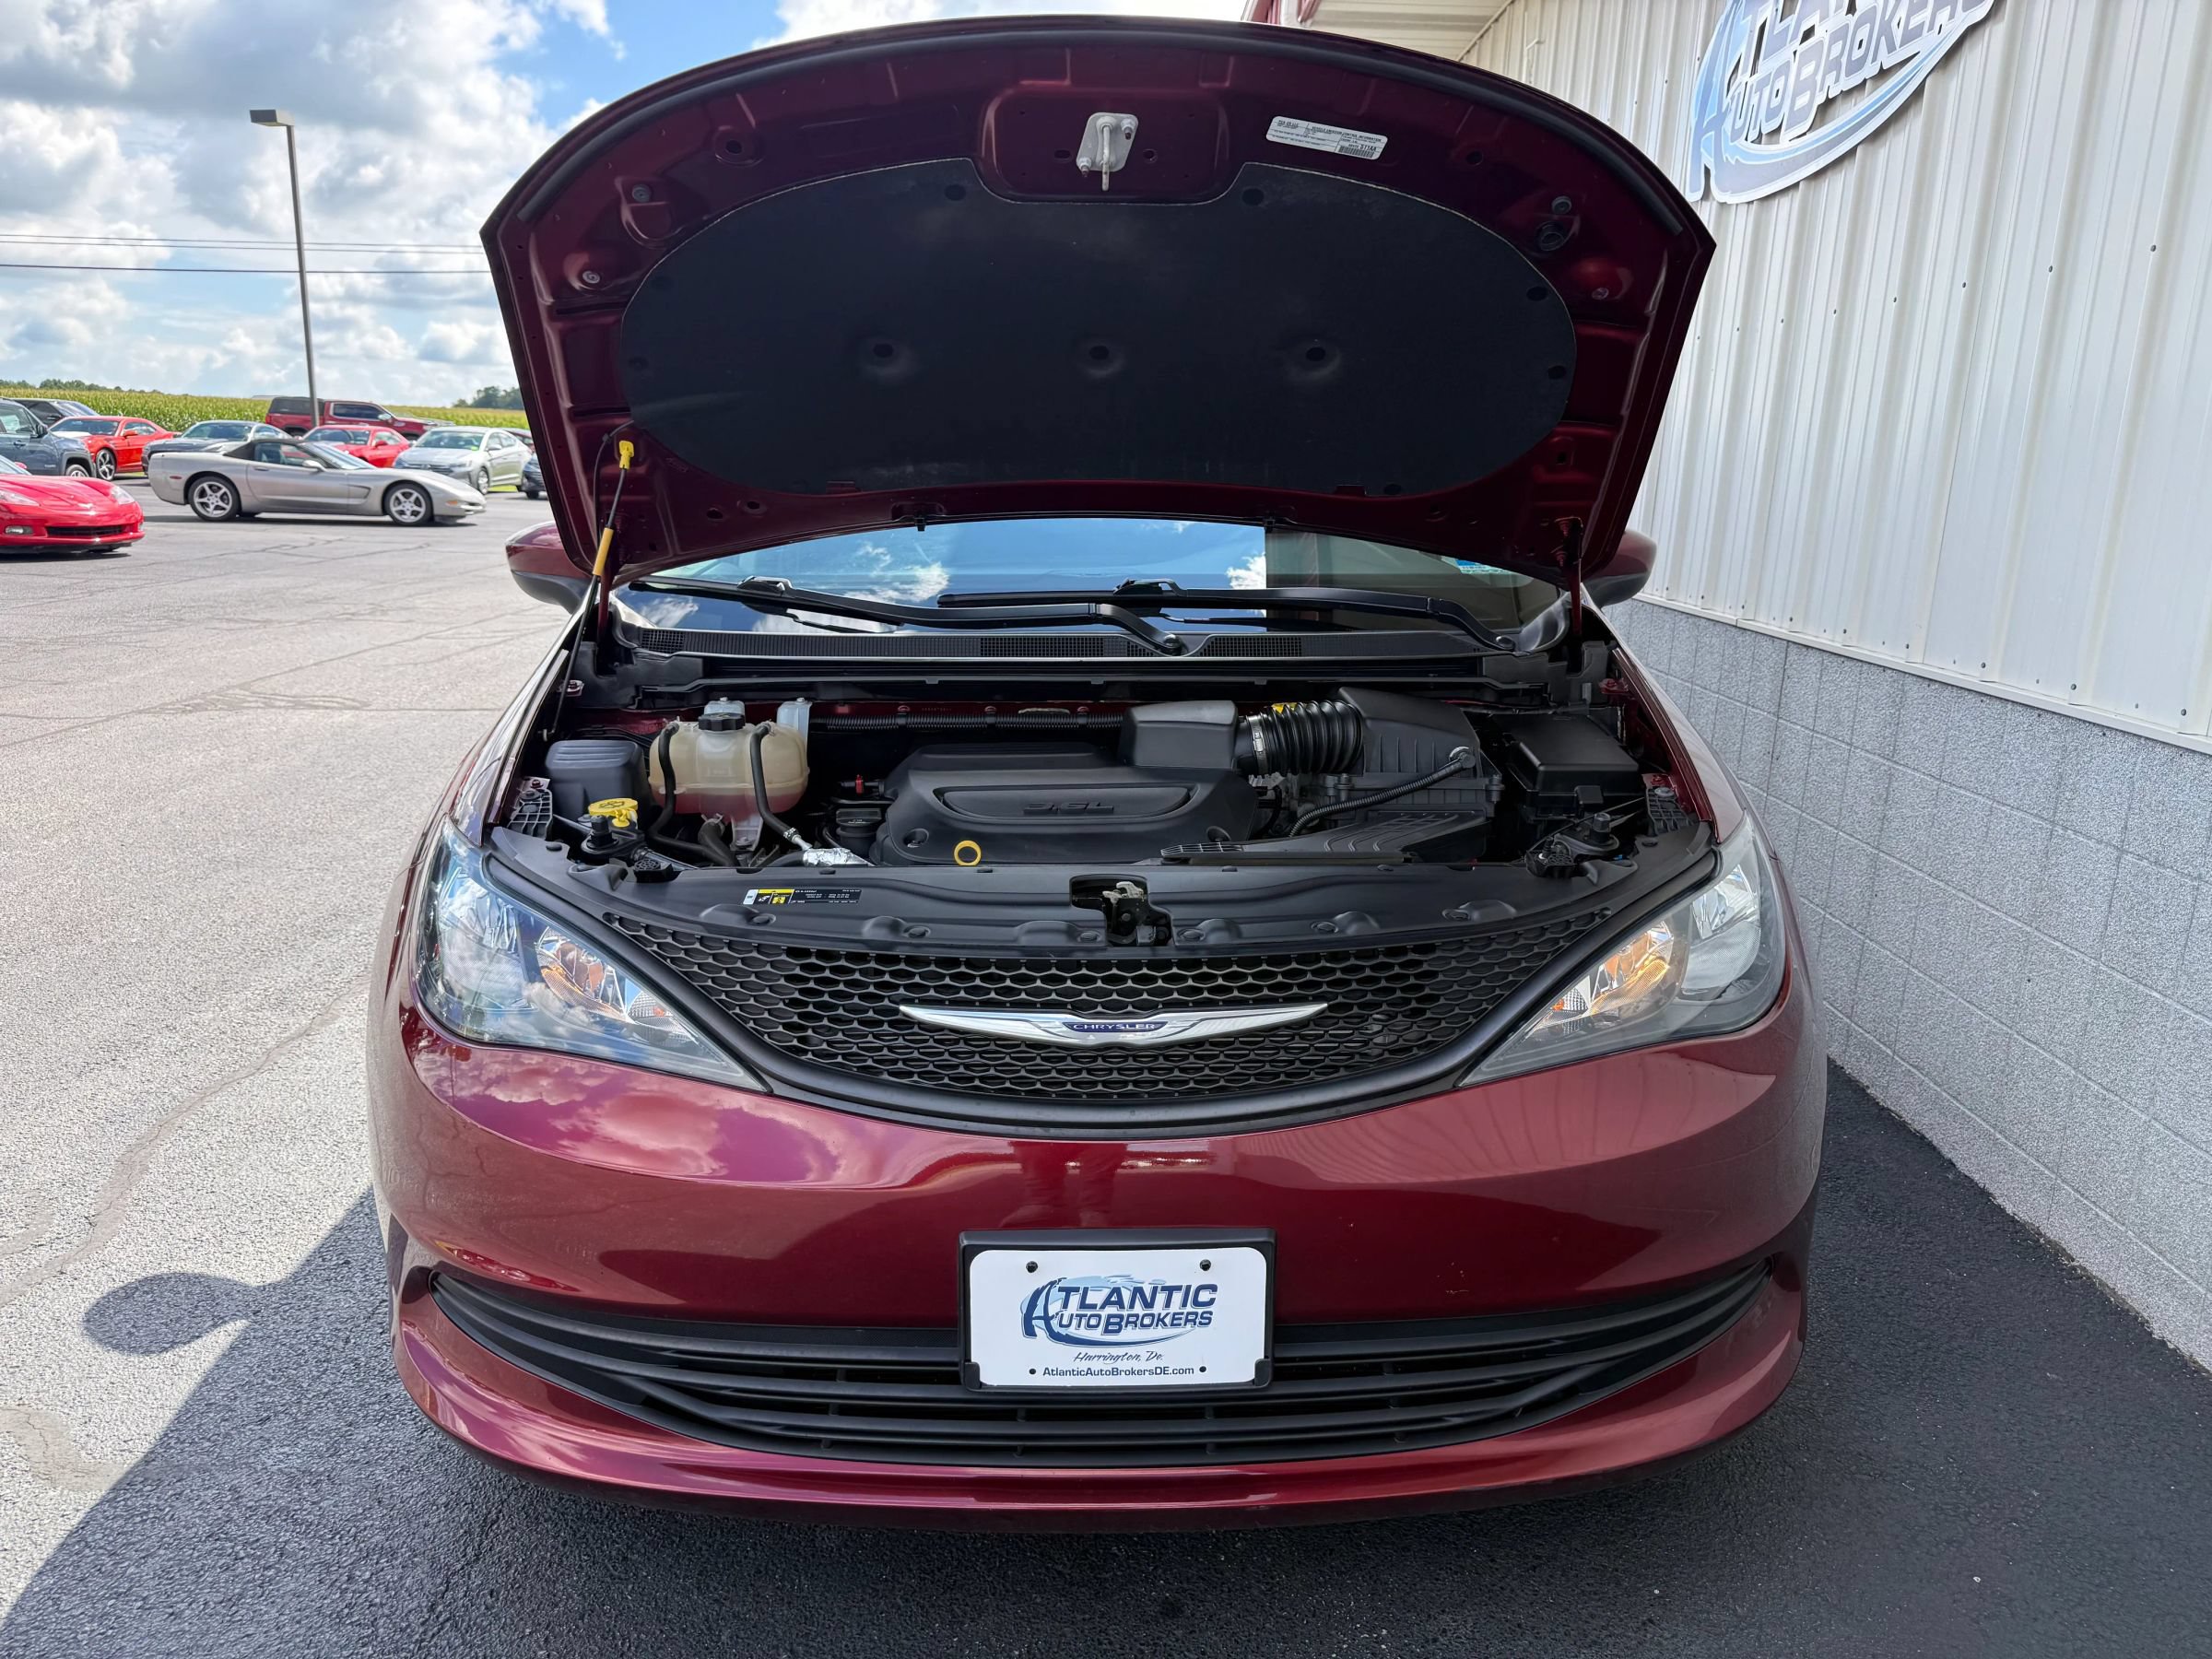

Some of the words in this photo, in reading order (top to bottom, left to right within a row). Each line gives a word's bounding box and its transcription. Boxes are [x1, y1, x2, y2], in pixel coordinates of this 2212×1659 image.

[1023, 1277, 1218, 1338] ATLANTIC
[1073, 1351, 1142, 1365] Harrington,
[1042, 1366, 1194, 1377] AtlanticAutoBrokersDE.com
